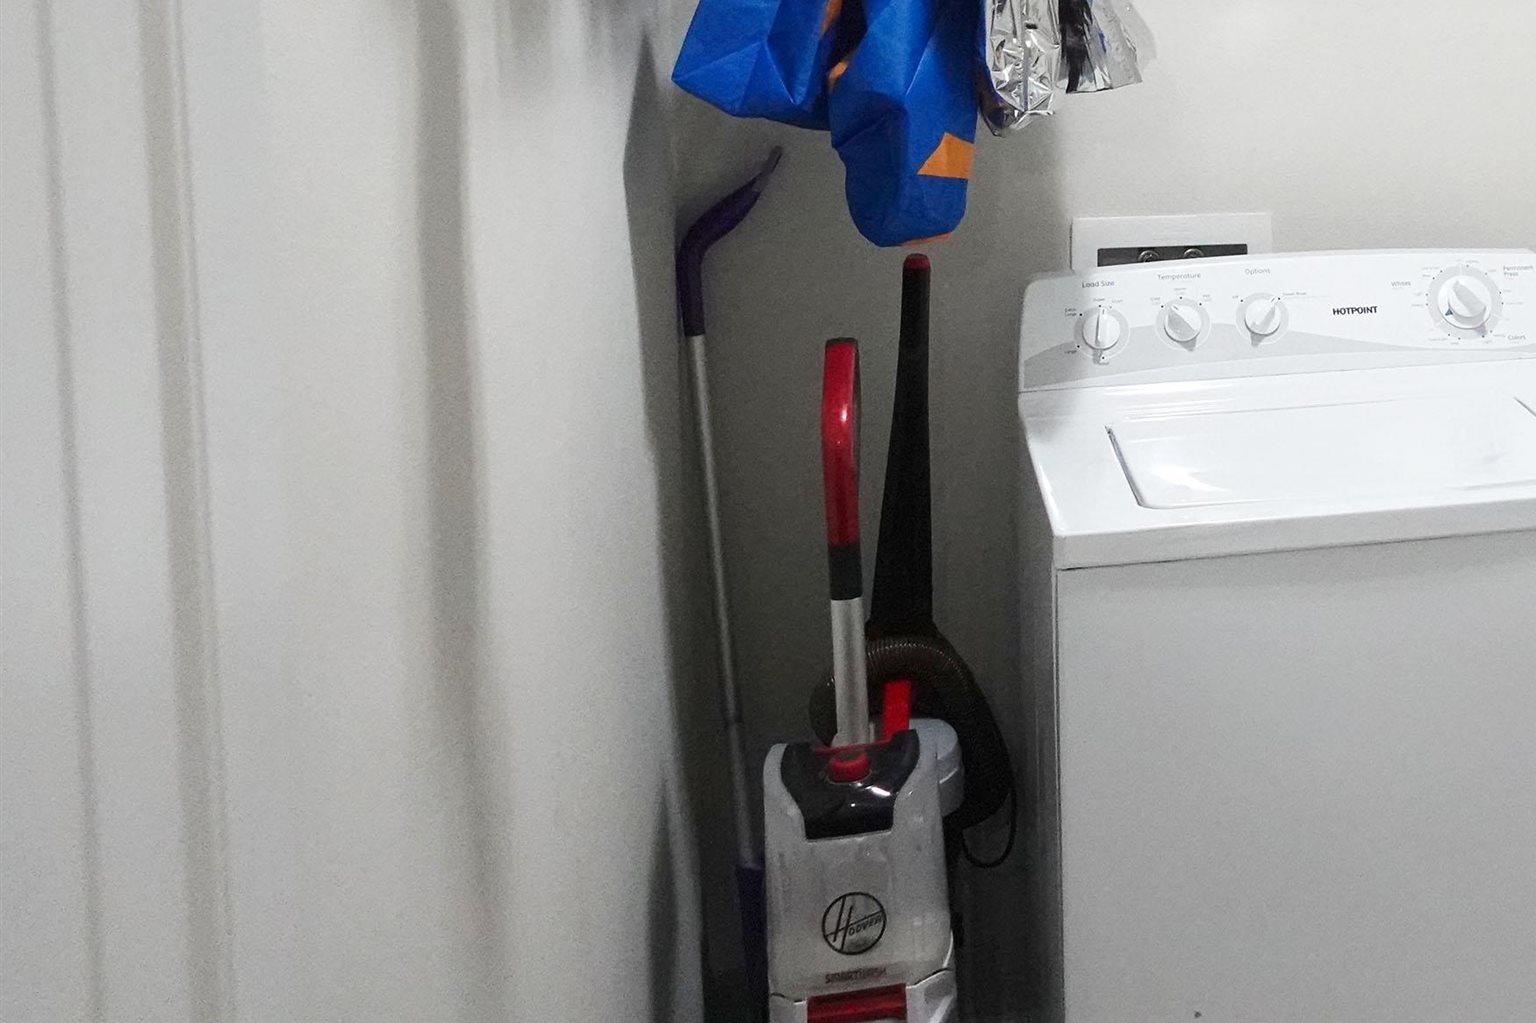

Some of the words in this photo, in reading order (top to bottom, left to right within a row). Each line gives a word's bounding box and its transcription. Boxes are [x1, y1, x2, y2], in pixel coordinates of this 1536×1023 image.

[1244, 267, 1271, 276] Options
[1157, 272, 1202, 282] Temperature
[1081, 280, 1100, 289] Load
[1100, 279, 1116, 287] Size
[1332, 305, 1379, 316] HOTPOINT
